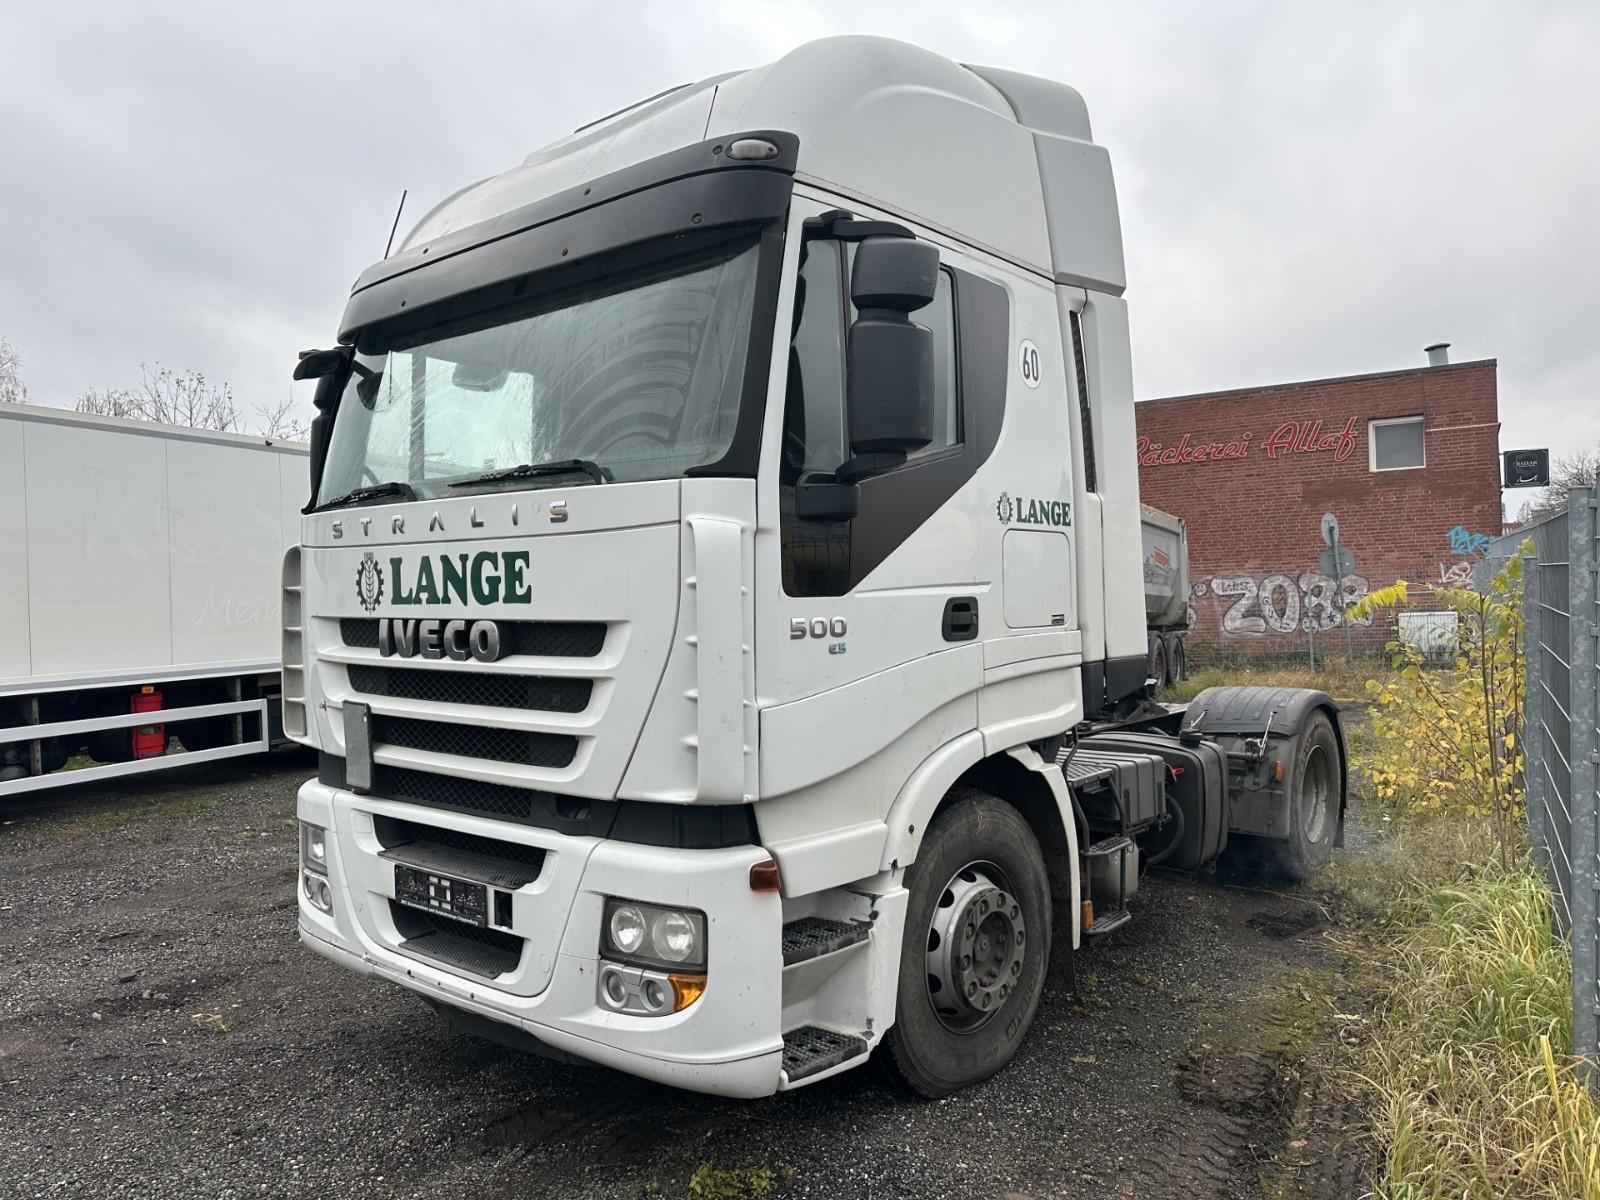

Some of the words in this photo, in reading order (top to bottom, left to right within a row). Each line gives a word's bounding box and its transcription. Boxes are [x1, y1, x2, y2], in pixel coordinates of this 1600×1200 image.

[1022, 346, 1039, 382] 60
[1261, 416, 1358, 462] Allaf
[332, 500, 569, 539] STRALIS
[1016, 498, 1072, 526] LANGE
[389, 551, 532, 607] LANGE
[378, 619, 502, 662] IVECO
[790, 616, 847, 640] 500
